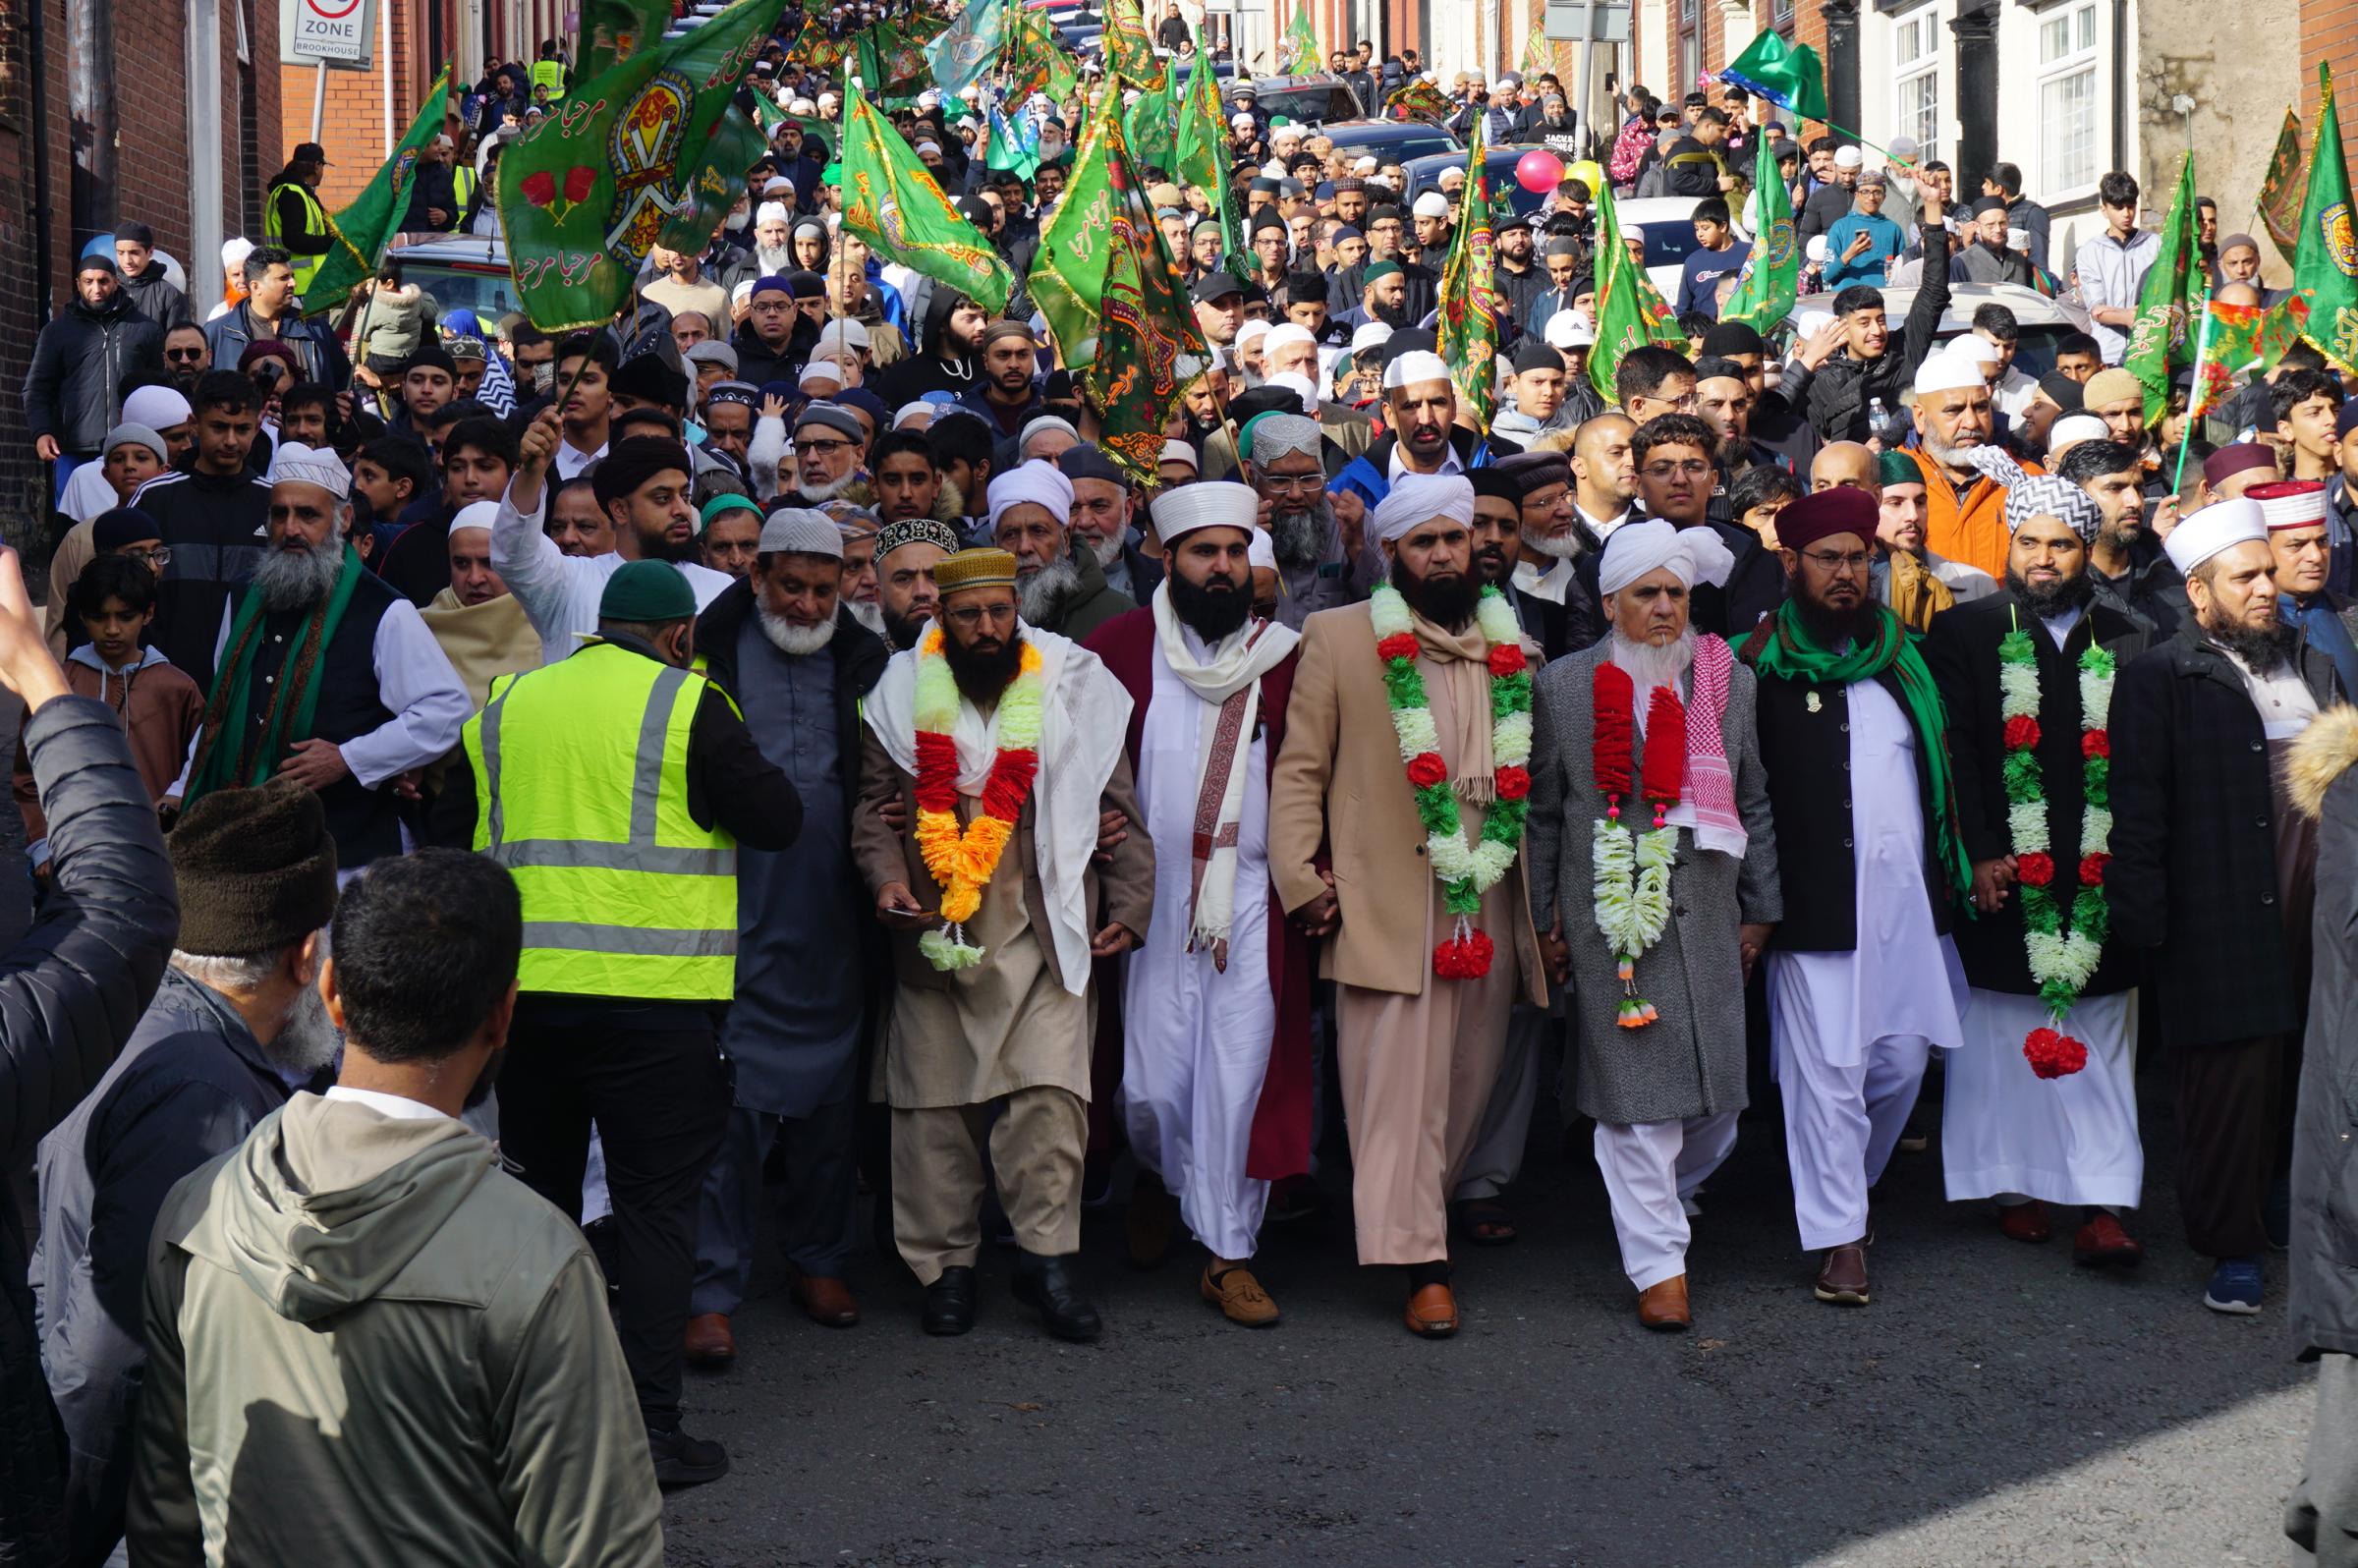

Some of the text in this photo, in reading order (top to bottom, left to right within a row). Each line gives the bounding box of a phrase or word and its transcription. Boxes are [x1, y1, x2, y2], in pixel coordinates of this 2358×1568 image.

[306, 20, 354, 37] ZONE
[296, 42, 359, 56] BROOKHOUSE
[558, 251, 603, 287] مرحبا
